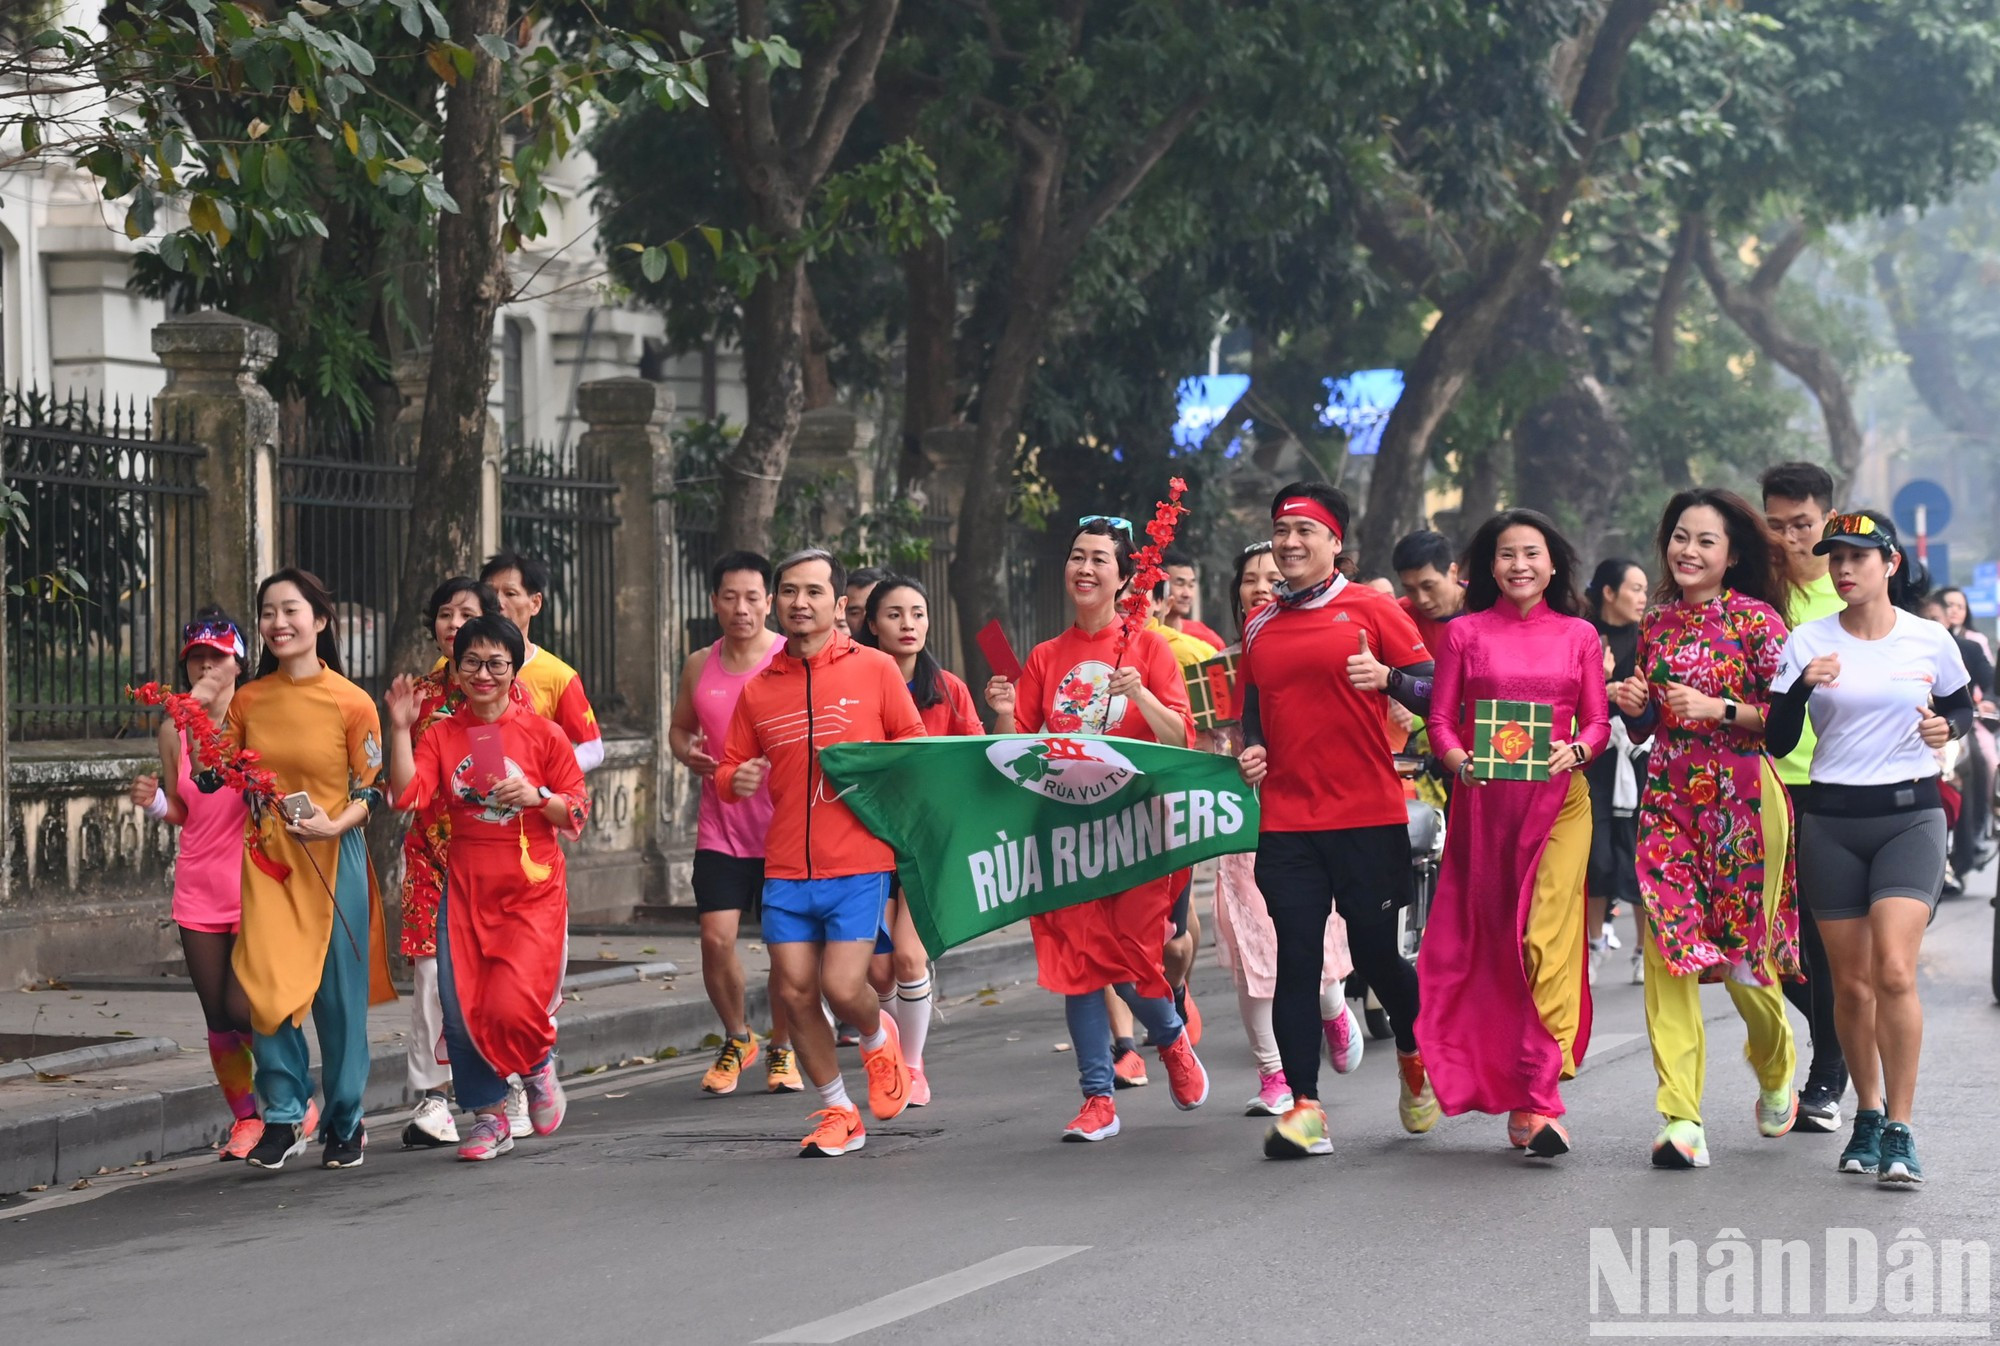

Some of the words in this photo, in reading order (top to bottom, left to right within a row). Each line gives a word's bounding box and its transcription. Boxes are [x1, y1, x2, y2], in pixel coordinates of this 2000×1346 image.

[1043, 779, 1076, 801] RÙA
[1079, 781, 1108, 801] VUI
[967, 830, 1044, 913] RÙA
[1051, 789, 1244, 887] RUNNERS
